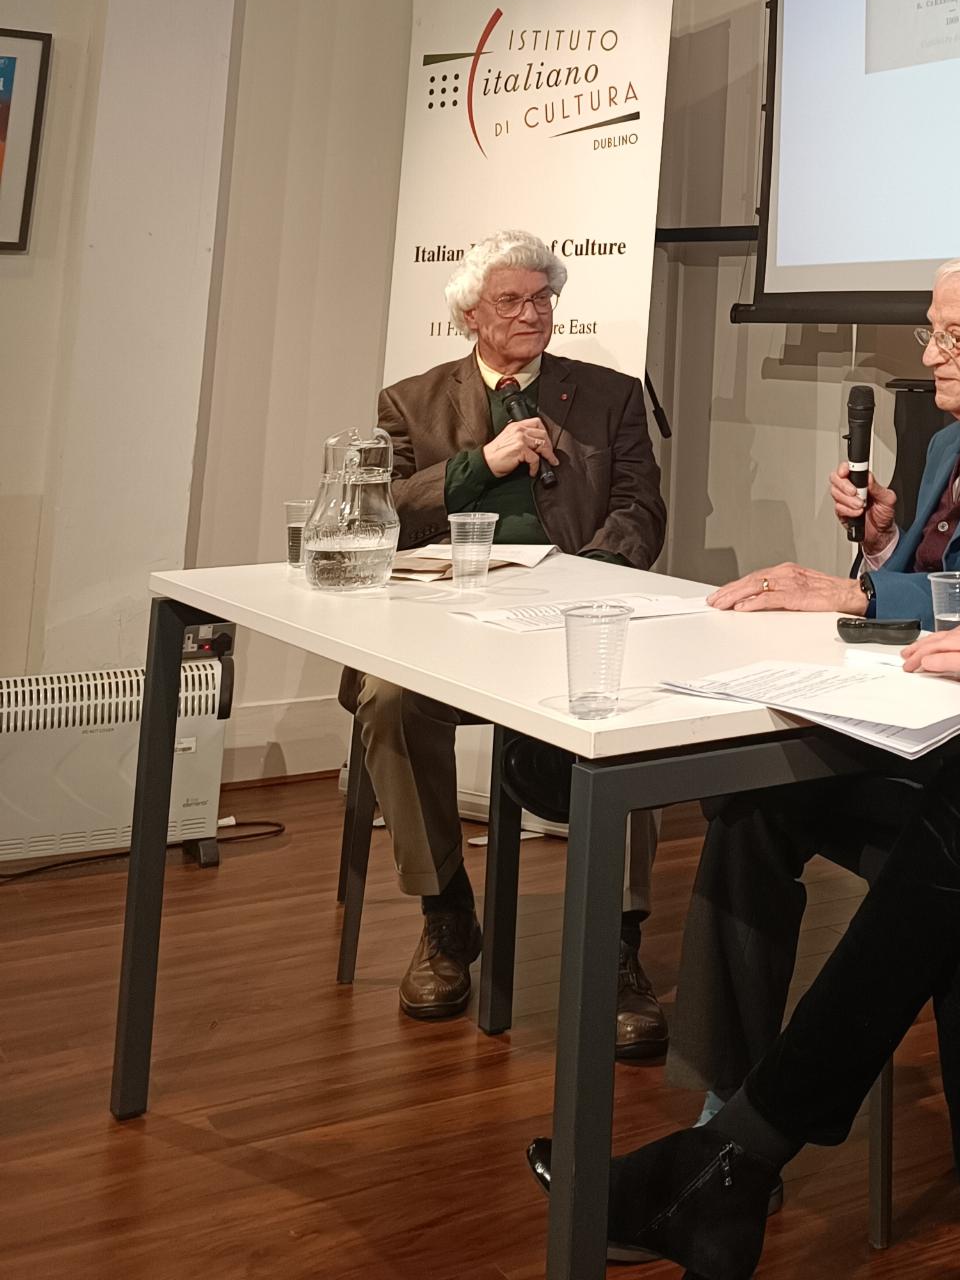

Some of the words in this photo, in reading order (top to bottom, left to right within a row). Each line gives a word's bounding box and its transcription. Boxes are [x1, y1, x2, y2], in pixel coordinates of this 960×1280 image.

[508, 29, 618, 51] ISTITUTO
[483, 62, 600, 96] italiano
[494, 119, 509, 137] DI
[524, 81, 639, 128] CULTURA
[593, 133, 639, 150] DUBLINO
[414, 245, 464, 263] Italian
[561, 239, 627, 257] Culture
[569, 319, 597, 335] East
